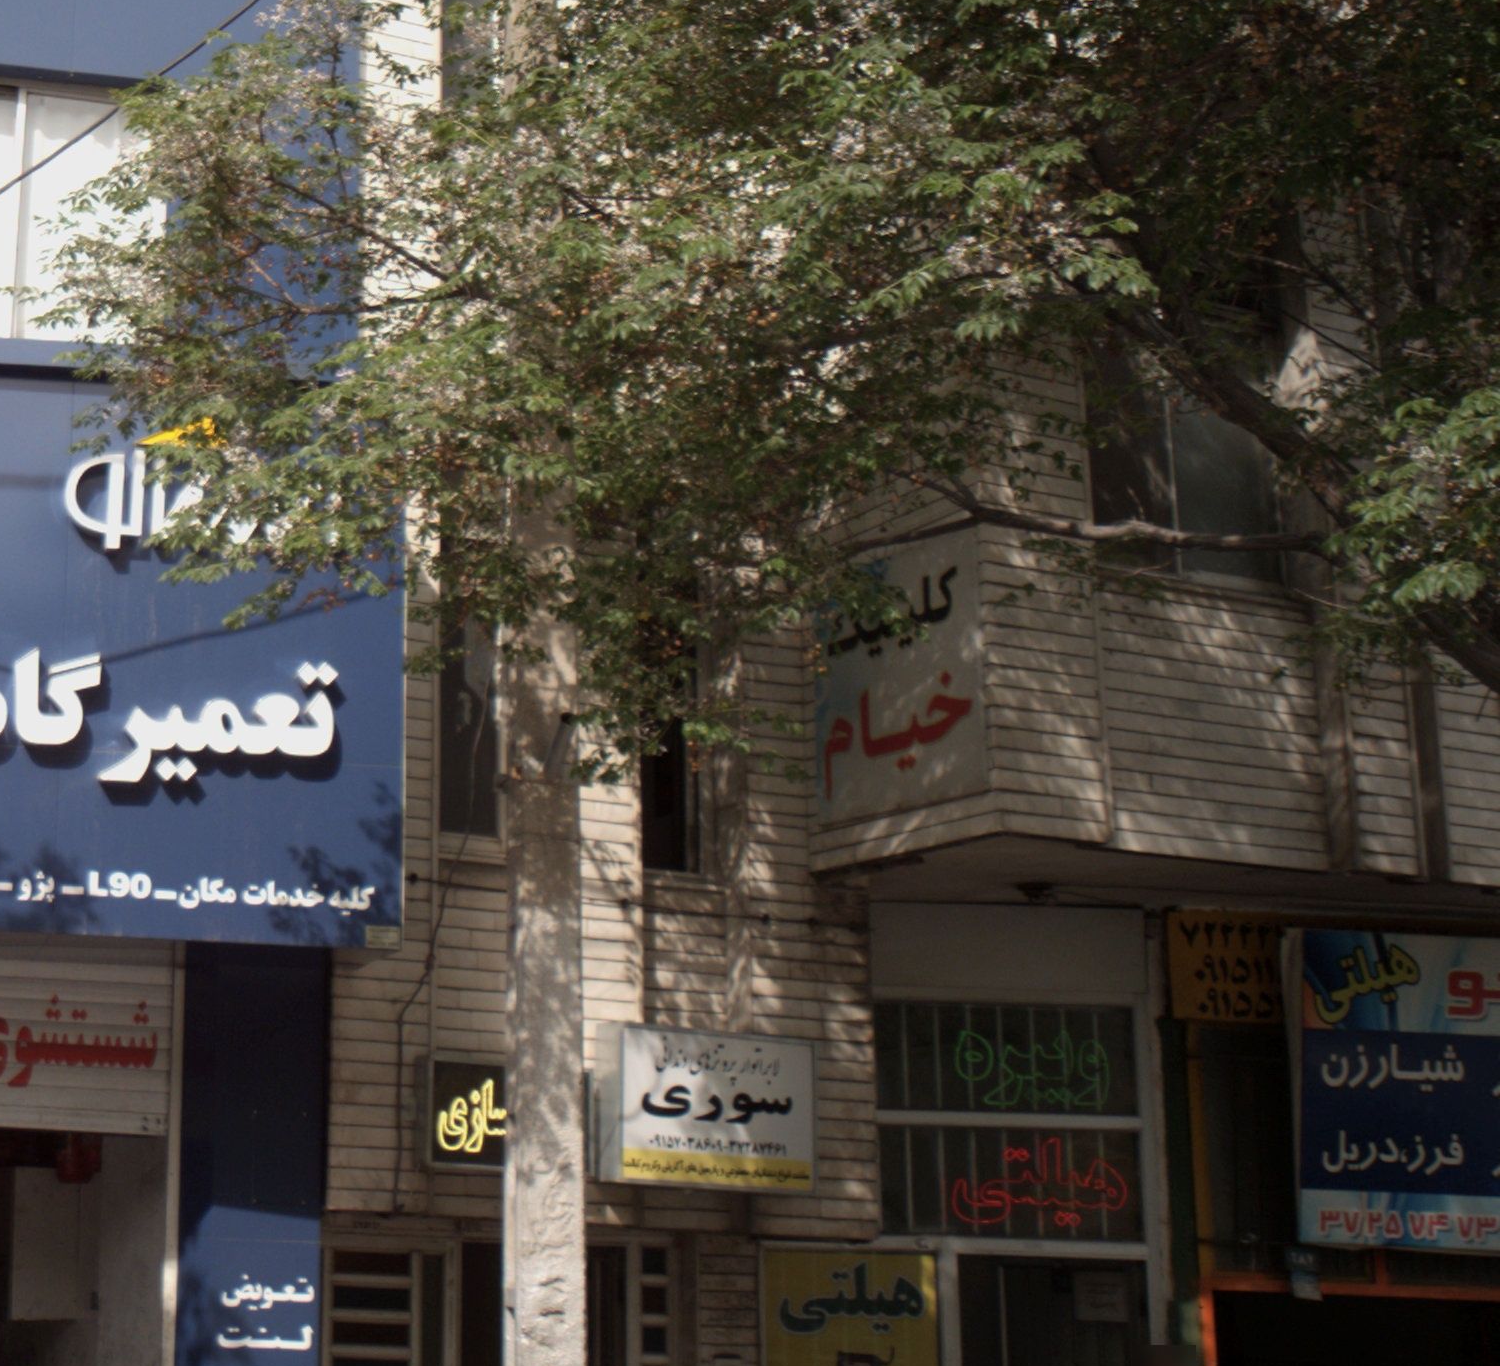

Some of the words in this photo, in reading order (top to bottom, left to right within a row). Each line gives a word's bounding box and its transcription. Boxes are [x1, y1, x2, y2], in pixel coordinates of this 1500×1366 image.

[825, 671, 973, 801] خیام
[18, 870, 56, 902] پژو
[87, 870, 153, 899] L90
[243, 880, 325, 908] خدمات
[329, 885, 375, 916] کلیه
[1315, 944, 1421, 1025] هیلتی
[642, 1085, 792, 1123] سوری
[951, 1137, 1130, 1227] هیلتی
[220, 1273, 315, 1311] تعویض
[779, 1262, 924, 1332] هیلتی
[216, 1324, 314, 1351] لنت
